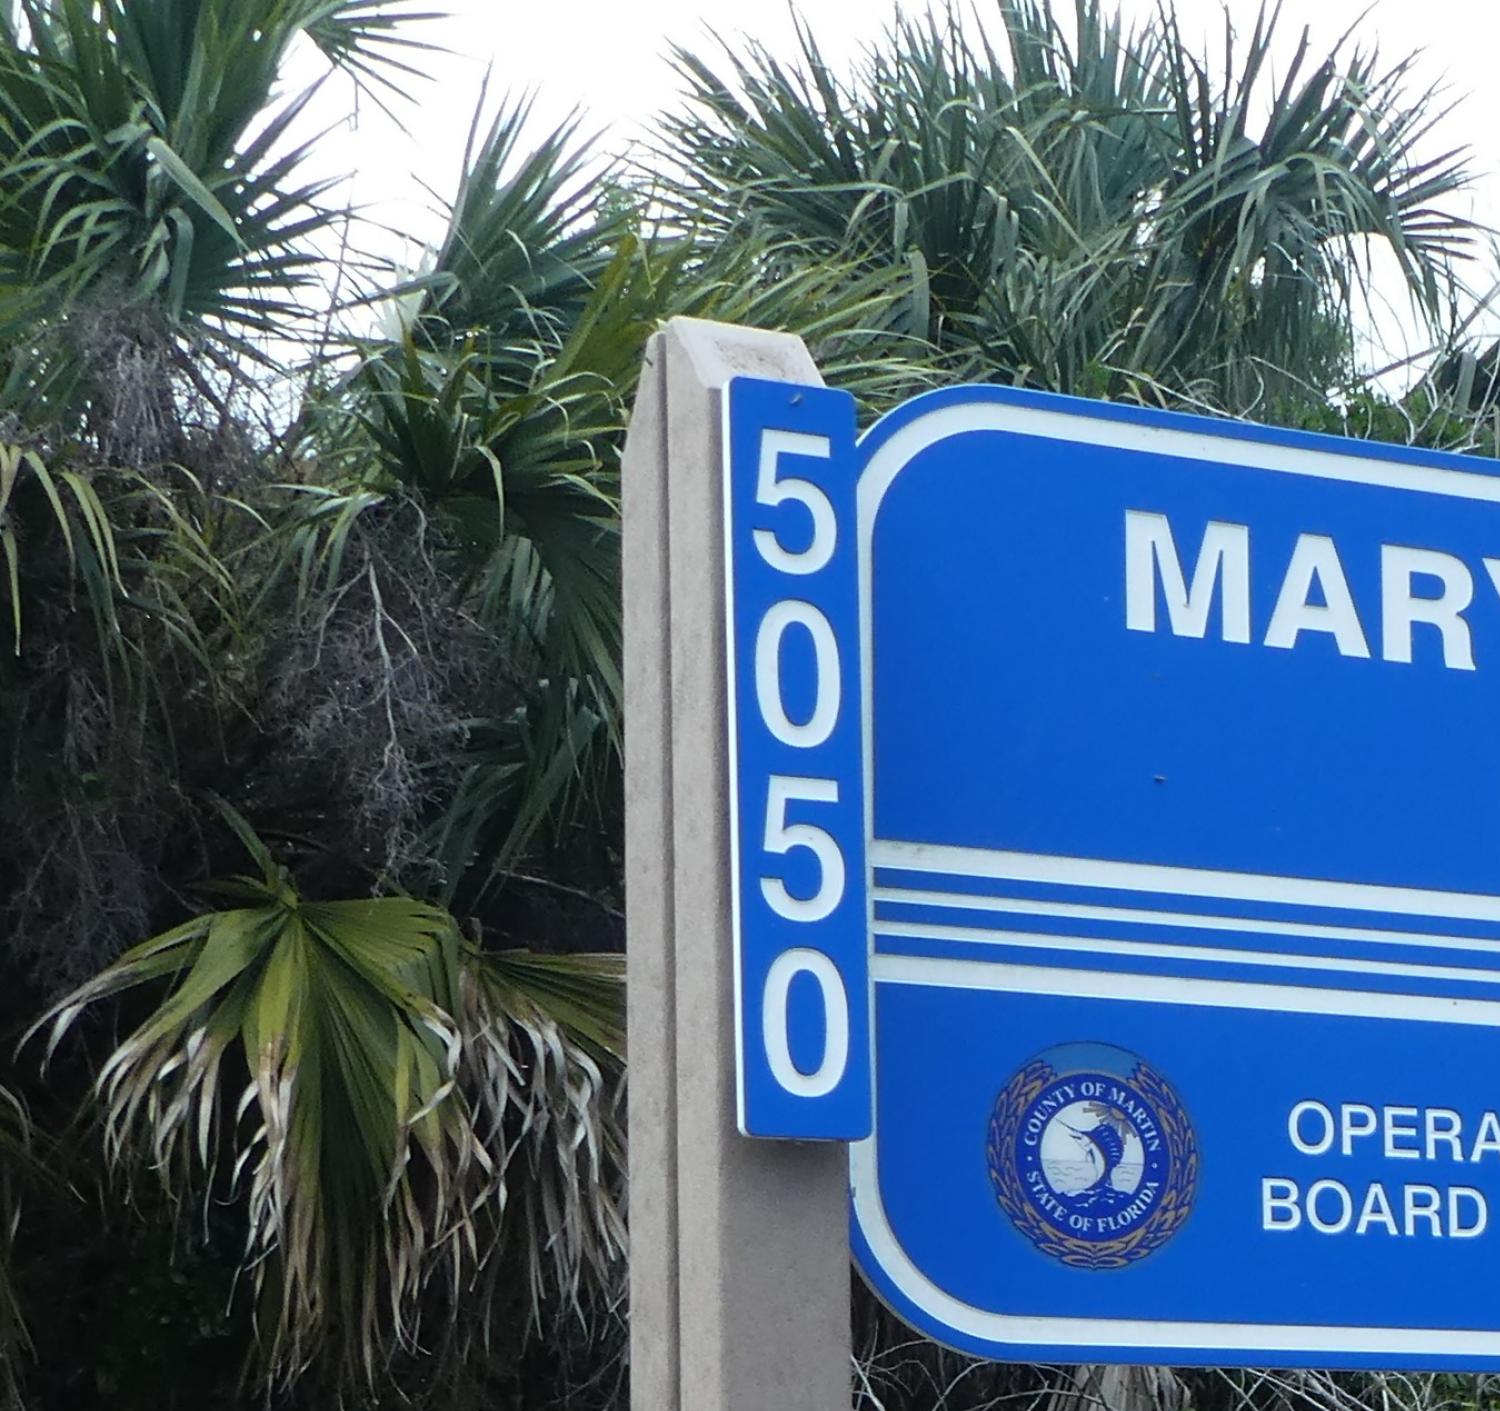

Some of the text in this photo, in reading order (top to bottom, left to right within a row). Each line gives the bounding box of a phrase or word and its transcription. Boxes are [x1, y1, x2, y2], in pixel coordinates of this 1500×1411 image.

[751, 428, 850, 1099] 5050
[1023, 1081, 1161, 1152] COUNTY OF MARTIN
[1026, 1170, 1161, 1234] STATE OF FLORIDA
[1262, 1178, 1487, 1239] BOARD
